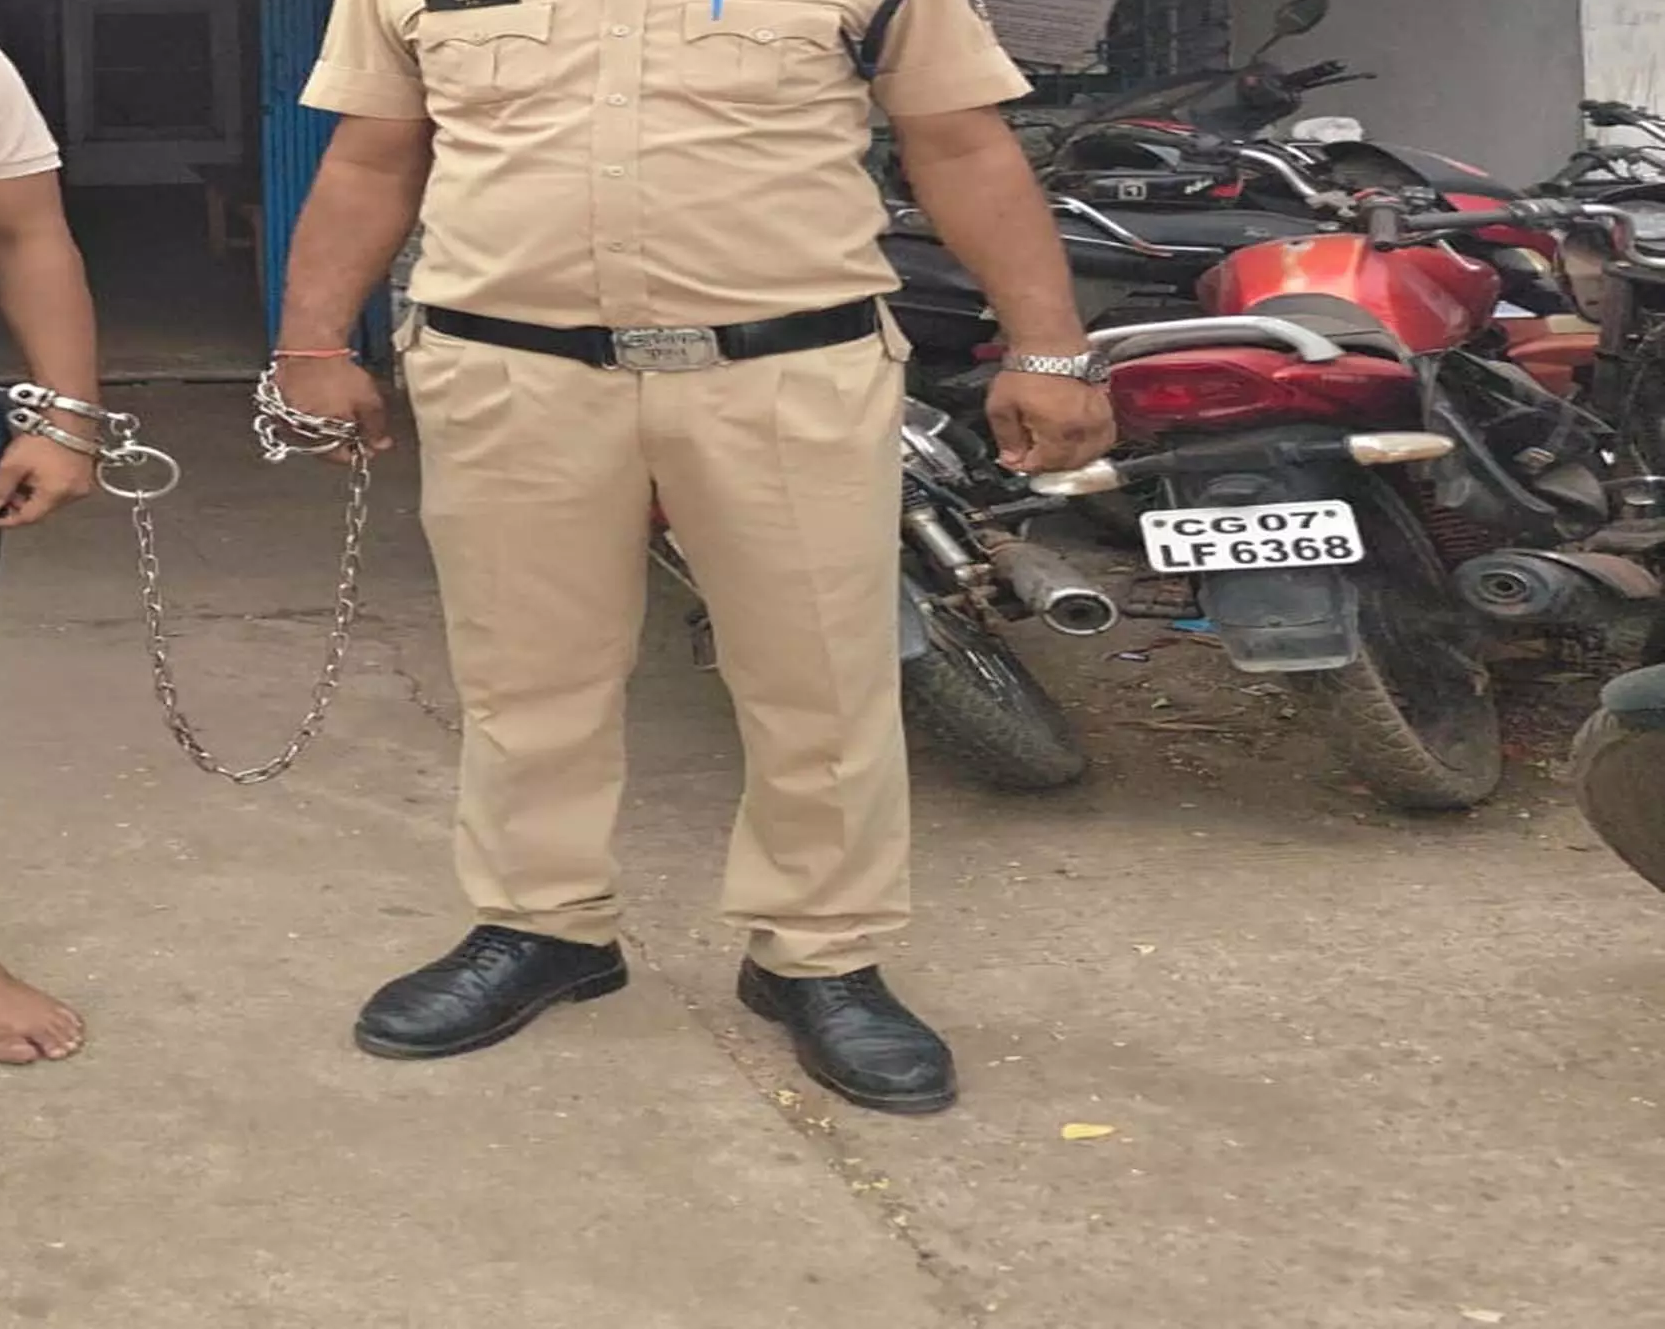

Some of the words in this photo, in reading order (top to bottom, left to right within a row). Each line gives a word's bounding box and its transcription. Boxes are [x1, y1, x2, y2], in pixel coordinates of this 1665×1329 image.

[1173, 516, 1247, 537] CG
[1257, 510, 1319, 532] 07
[1160, 542, 1217, 567] LF
[1230, 534, 1354, 564] 6368
